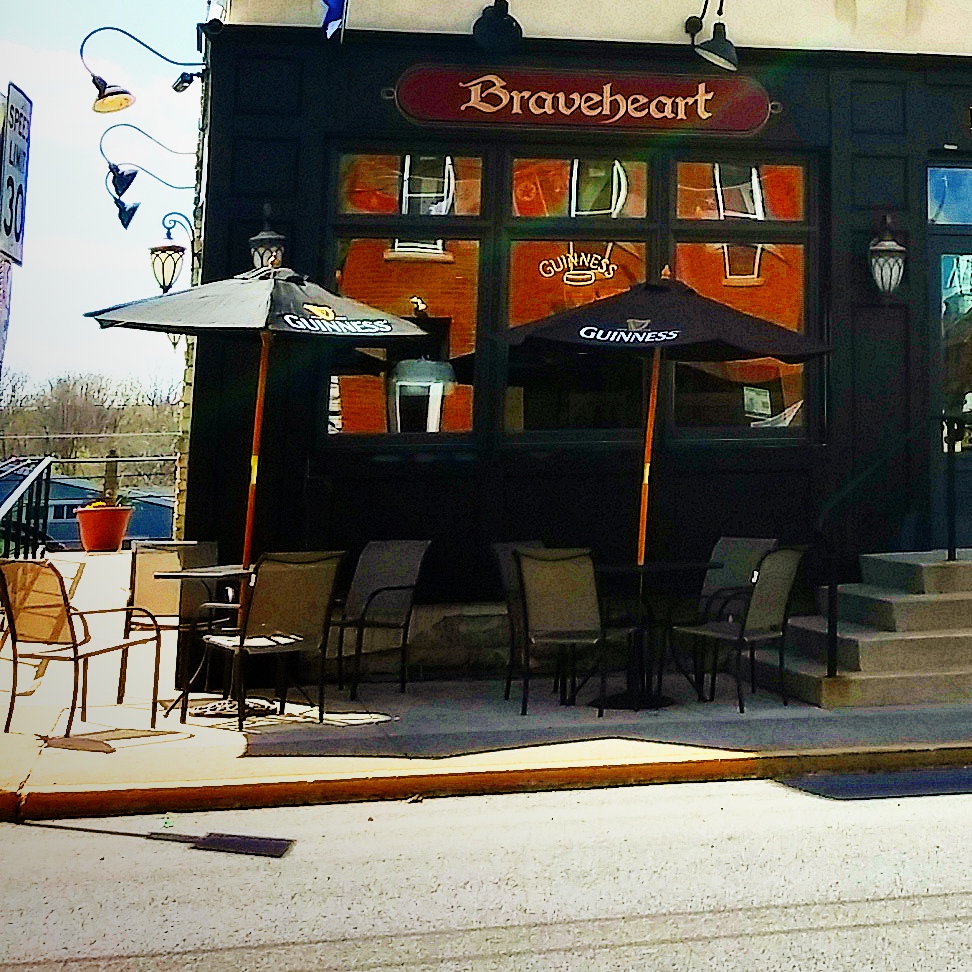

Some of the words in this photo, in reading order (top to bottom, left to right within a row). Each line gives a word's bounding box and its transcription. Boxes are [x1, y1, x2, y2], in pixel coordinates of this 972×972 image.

[459, 74, 715, 124] Braveheart
[3, 175, 25, 243] 30
[538, 251, 618, 279] GUINNESS
[282, 313, 393, 333] GUINNESS
[579, 326, 682, 343] GUINNESS
